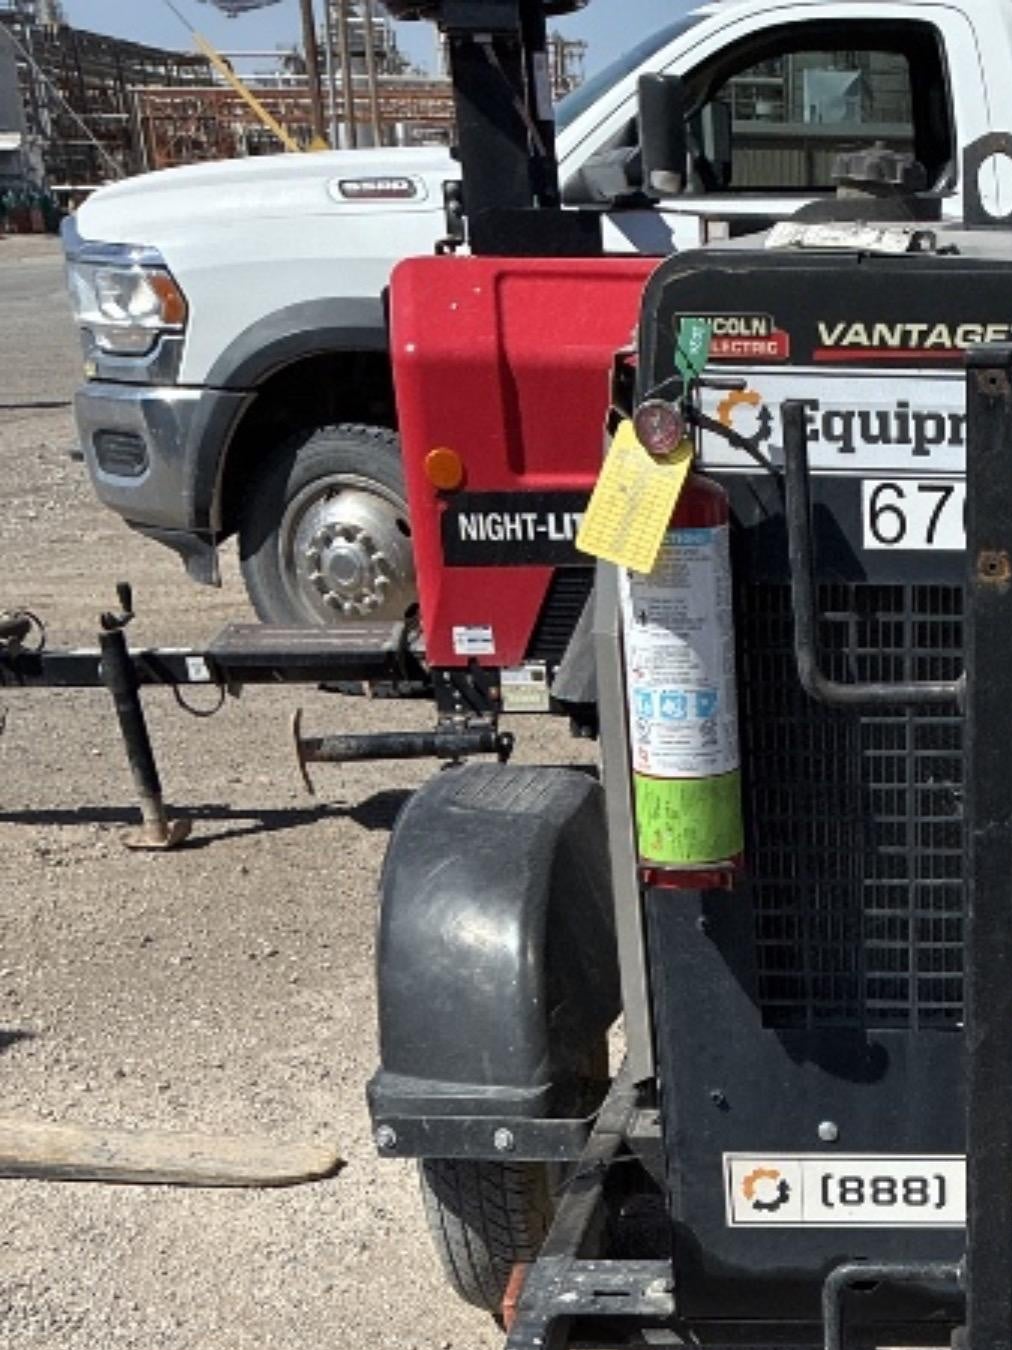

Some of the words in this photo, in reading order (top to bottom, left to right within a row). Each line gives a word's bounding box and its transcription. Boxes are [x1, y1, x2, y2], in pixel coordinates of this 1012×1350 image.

[711, 340, 778, 355] LECTRIC
[816, 320, 1010, 349] VANTAGE
[820, 1172, 947, 1210] (888)
